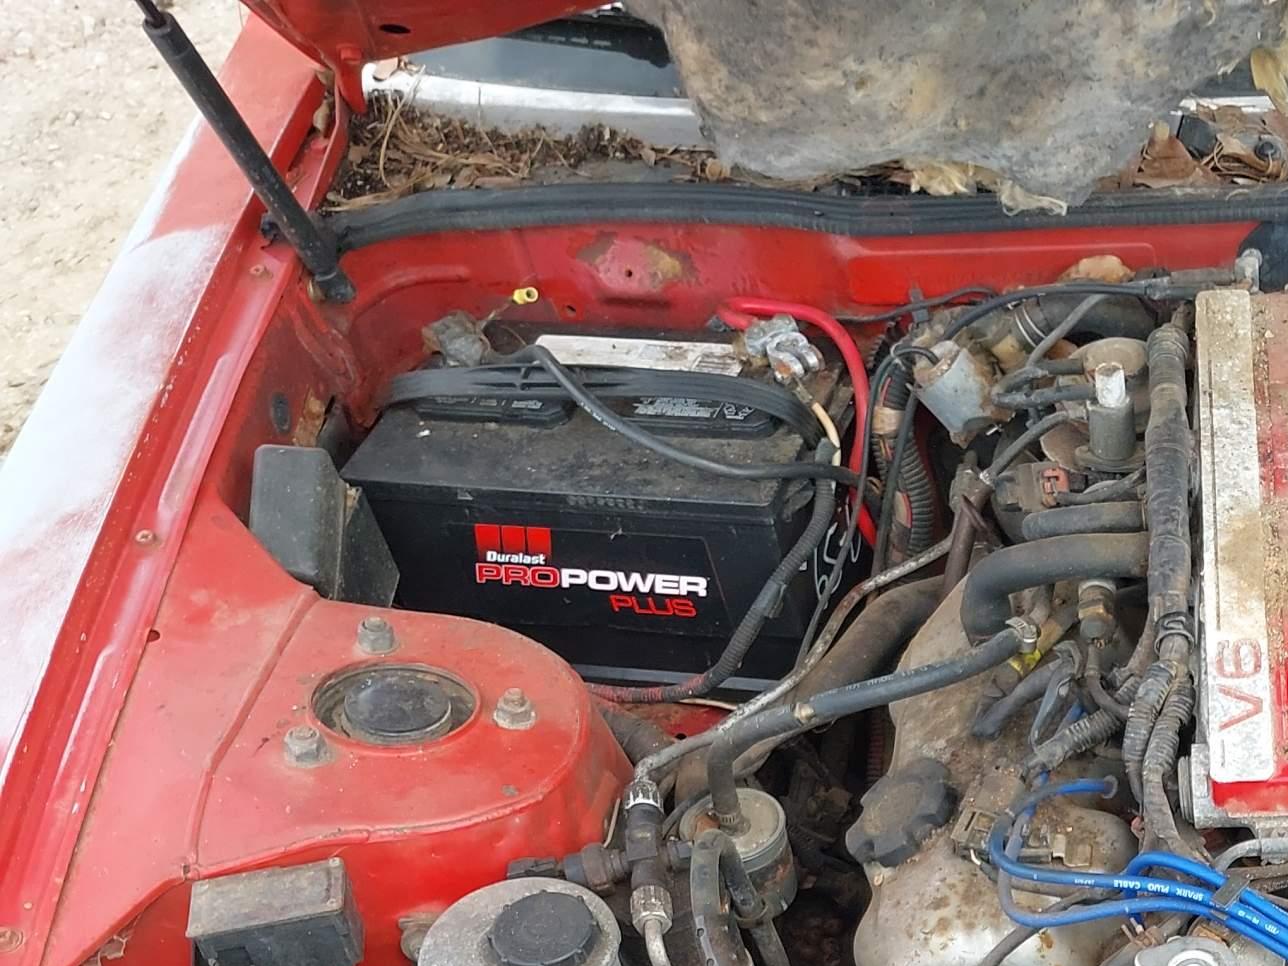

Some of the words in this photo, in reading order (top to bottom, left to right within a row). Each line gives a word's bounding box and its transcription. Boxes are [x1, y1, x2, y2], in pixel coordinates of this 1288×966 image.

[485, 549, 546, 565] Duralast
[610, 594, 698, 618] PLUS
[1214, 640, 1264, 733] V6
[1112, 878, 1142, 891] CABLE
[1146, 882, 1169, 894] PLUG
[1175, 886, 1204, 902] SPARK
